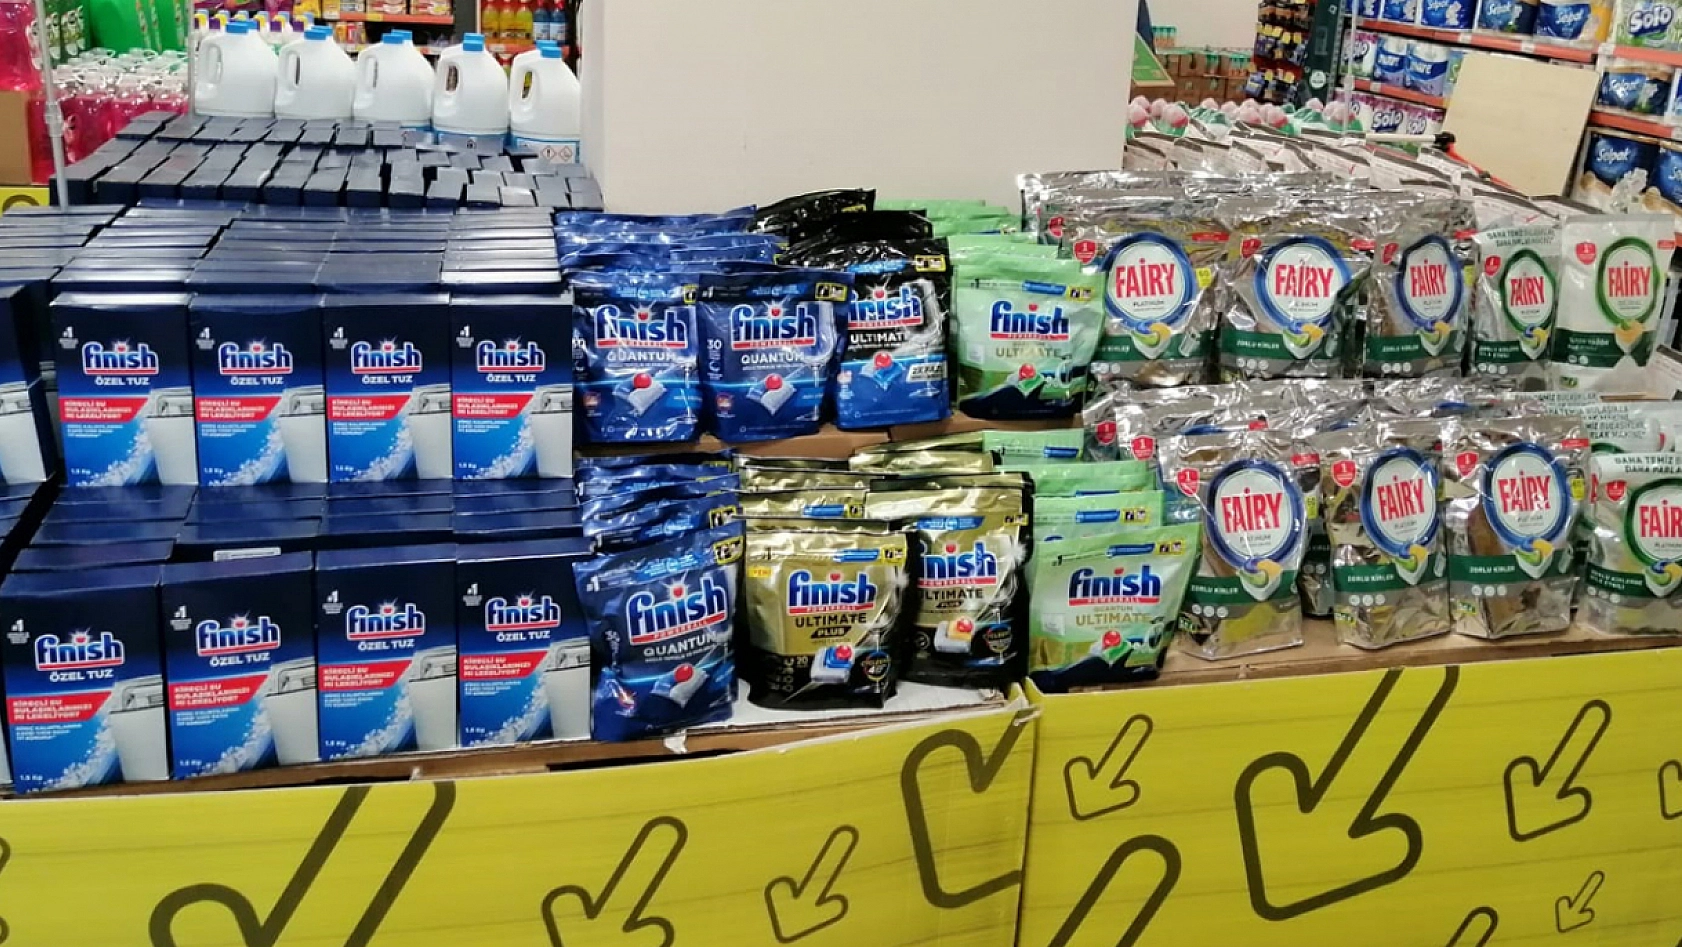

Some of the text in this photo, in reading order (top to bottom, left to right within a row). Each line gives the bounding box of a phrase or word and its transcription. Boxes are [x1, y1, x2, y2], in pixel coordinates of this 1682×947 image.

[1630, 6, 1672, 33] Solo
[1373, 108, 1404, 130] Solo
[848, 286, 923, 322] inish
[595, 305, 688, 340] finish
[731, 304, 815, 341] finish
[990, 299, 1070, 334] finish
[707, 340, 722, 350] 30
[851, 333, 906, 343] ULTIMAT
[83, 341, 158, 368] finish
[219, 341, 292, 368] finish
[351, 341, 422, 367] finish
[477, 340, 545, 366] finish
[741, 351, 806, 364] QUANTUM
[996, 348, 1061, 357] ULTATE
[95, 376, 150, 386] ÖZEL TUZ
[231, 376, 284, 386] ÖZEL TUZ
[362, 374, 413, 384] ÖZEL TUZ
[486, 373, 536, 383] ÖZEL TUZ
[922, 541, 998, 579] nish
[788, 570, 877, 607] finish
[1069, 564, 1161, 599] finish
[925, 589, 984, 601] LTIMATE
[347, 604, 425, 634] finish
[485, 597, 560, 625] finish
[627, 577, 727, 638] finish
[1075, 613, 1151, 625] ULTIMATE
[795, 613, 867, 627] ULTIMATE
[196, 617, 280, 650] finish
[358, 639, 415, 651] ÖZEL TUZ
[496, 630, 550, 642] ÖZEL TUZ
[817, 630, 846, 638] PLUS
[36, 632, 124, 664] finish
[643, 635, 719, 658] QUANTUM
[210, 651, 270, 667] ÖZEL TUZ
[50, 669, 114, 682] ÖZEL TUZ
